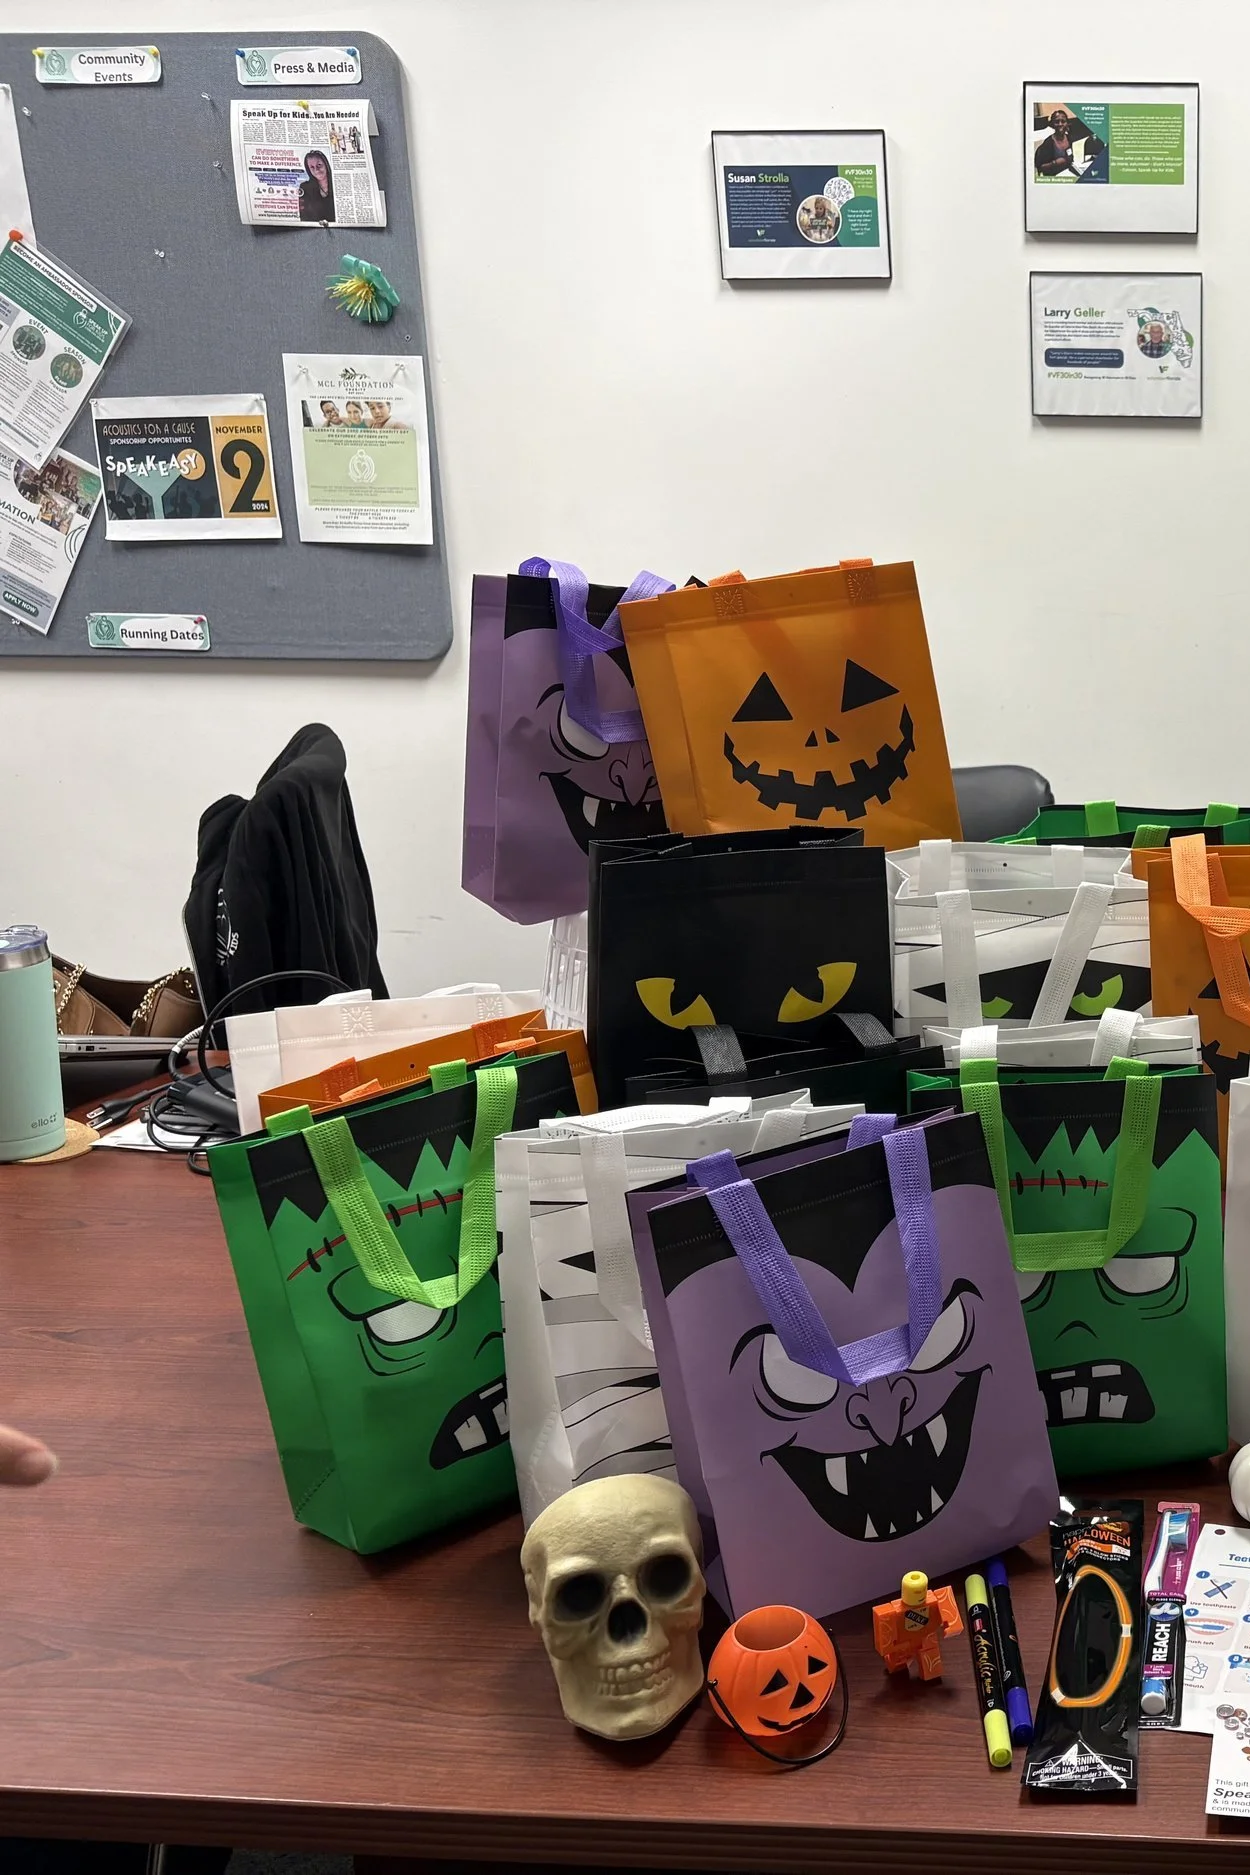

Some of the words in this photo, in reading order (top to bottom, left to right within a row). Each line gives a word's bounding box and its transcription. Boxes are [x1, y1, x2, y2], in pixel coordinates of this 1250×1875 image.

[78, 53, 145, 66] Community
[274, 63, 305, 74] Press
[307, 62, 315, 73] &
[317, 62, 355, 73] Media
[95, 72, 133, 82] Events
[242, 110, 266, 118] Speak
[268, 111, 278, 119] Up
[256, 148, 294, 157] EVERYONE
[728, 173, 756, 184] Susan
[758, 173, 790, 183] Strolla
[13, 245, 34, 264] BECOME
[34, 260, 42, 269] AN
[41, 266, 72, 293] AMBASSADOR
[72, 290, 94, 310] SPONSOR
[1044, 307, 1072, 319] Larry
[1073, 307, 1105, 318] Geller
[28, 318, 49, 335] EVENT
[63, 346, 87, 365] SEASON
[1048, 372, 1083, 380] #VF30in30
[338, 381, 395, 389] FOUNDATION
[103, 424, 142, 436] ACOUSTICS
[164, 424, 169, 434] A
[172, 422, 196, 434] CAUSE
[215, 426, 263, 435] NOVEMBER
[105, 453, 198, 477] SPEAKEASY
[221, 439, 265, 513] 2
[252, 502, 269, 511] 2024
[4, 592, 20, 605] APPLY
[21, 600, 37, 614] NOW
[121, 629, 168, 642] Running
[170, 630, 205, 640] Dates
[228, 932, 239, 956] KIDS
[31, 1118, 49, 1129] ello
[1202, 1602, 1237, 1610] toothpaste
[1152, 1623, 1171, 1662] REACH
[1235, 1780, 1249, 1789] gift
